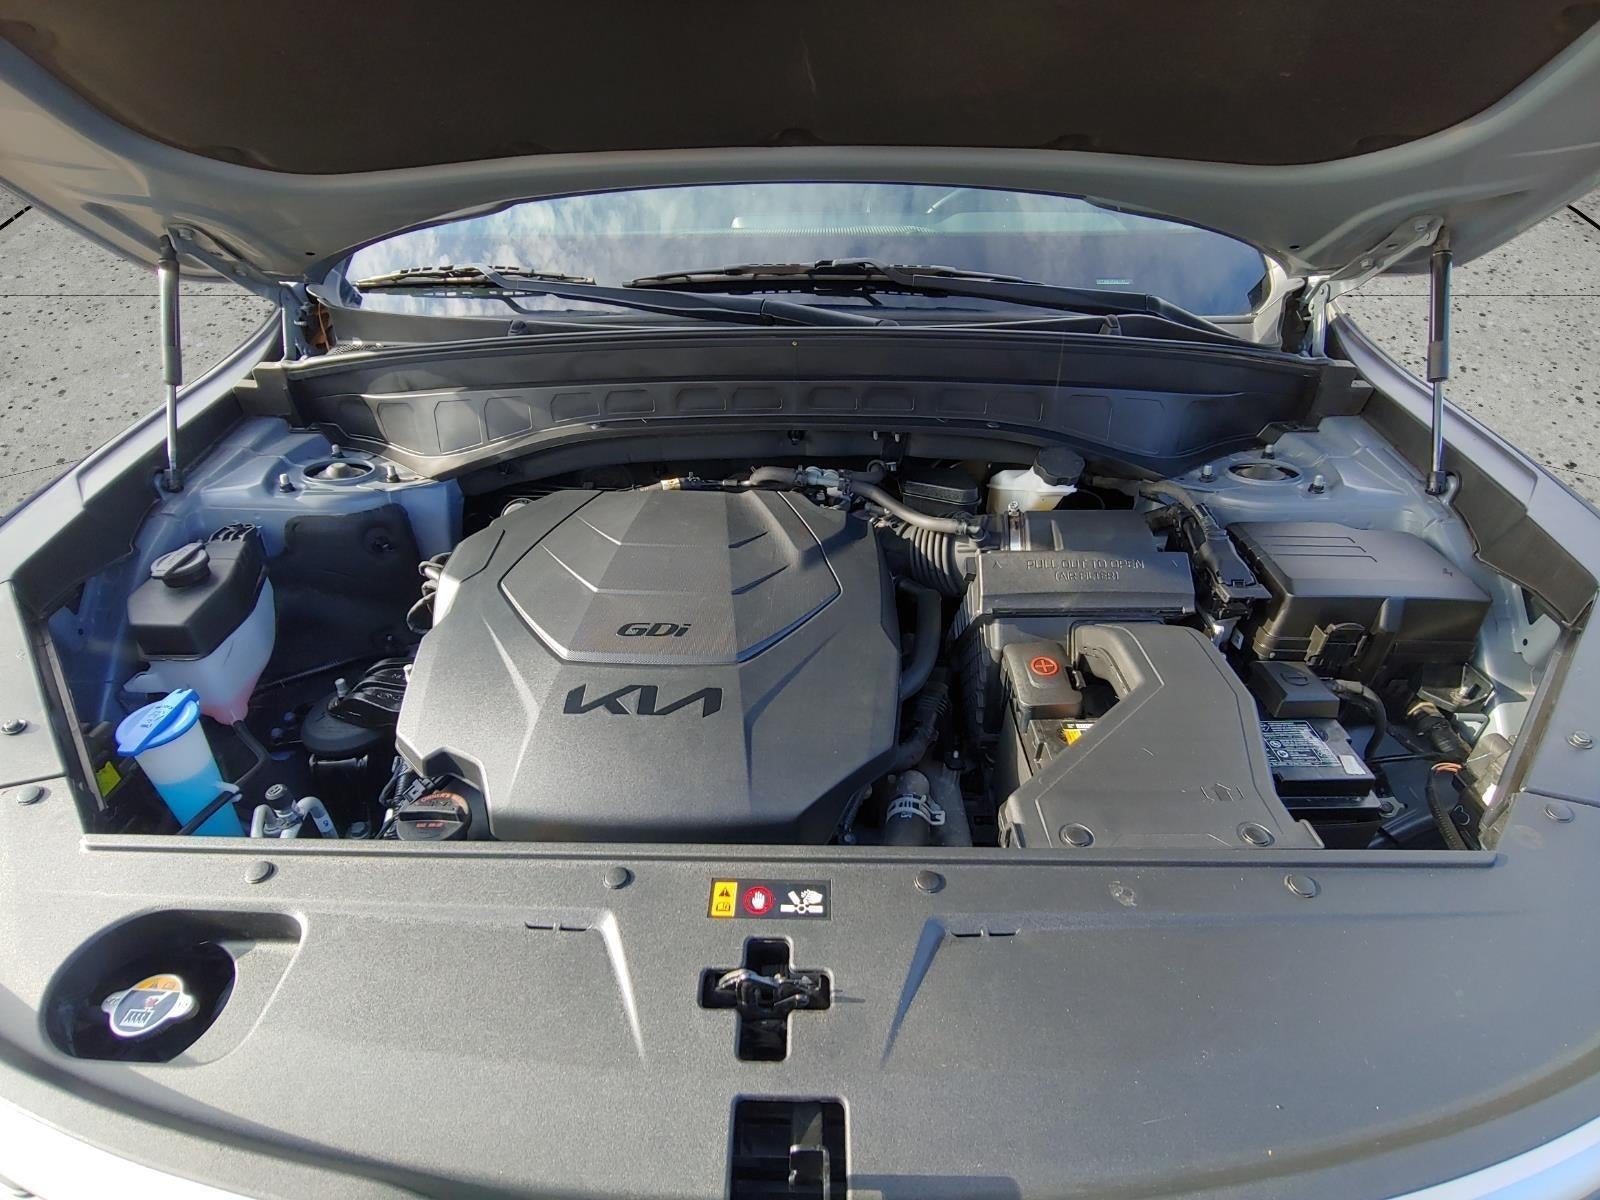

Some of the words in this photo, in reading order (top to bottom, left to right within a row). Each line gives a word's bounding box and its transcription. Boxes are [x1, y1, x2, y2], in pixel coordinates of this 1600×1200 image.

[1026, 559, 1057, 570] PULL
[1061, 559, 1088, 570] OUT
[1092, 559, 1107, 570] TO
[1110, 559, 1145, 570] OPEN
[616, 622, 692, 637] GDi
[563, 683, 724, 718] KIA
